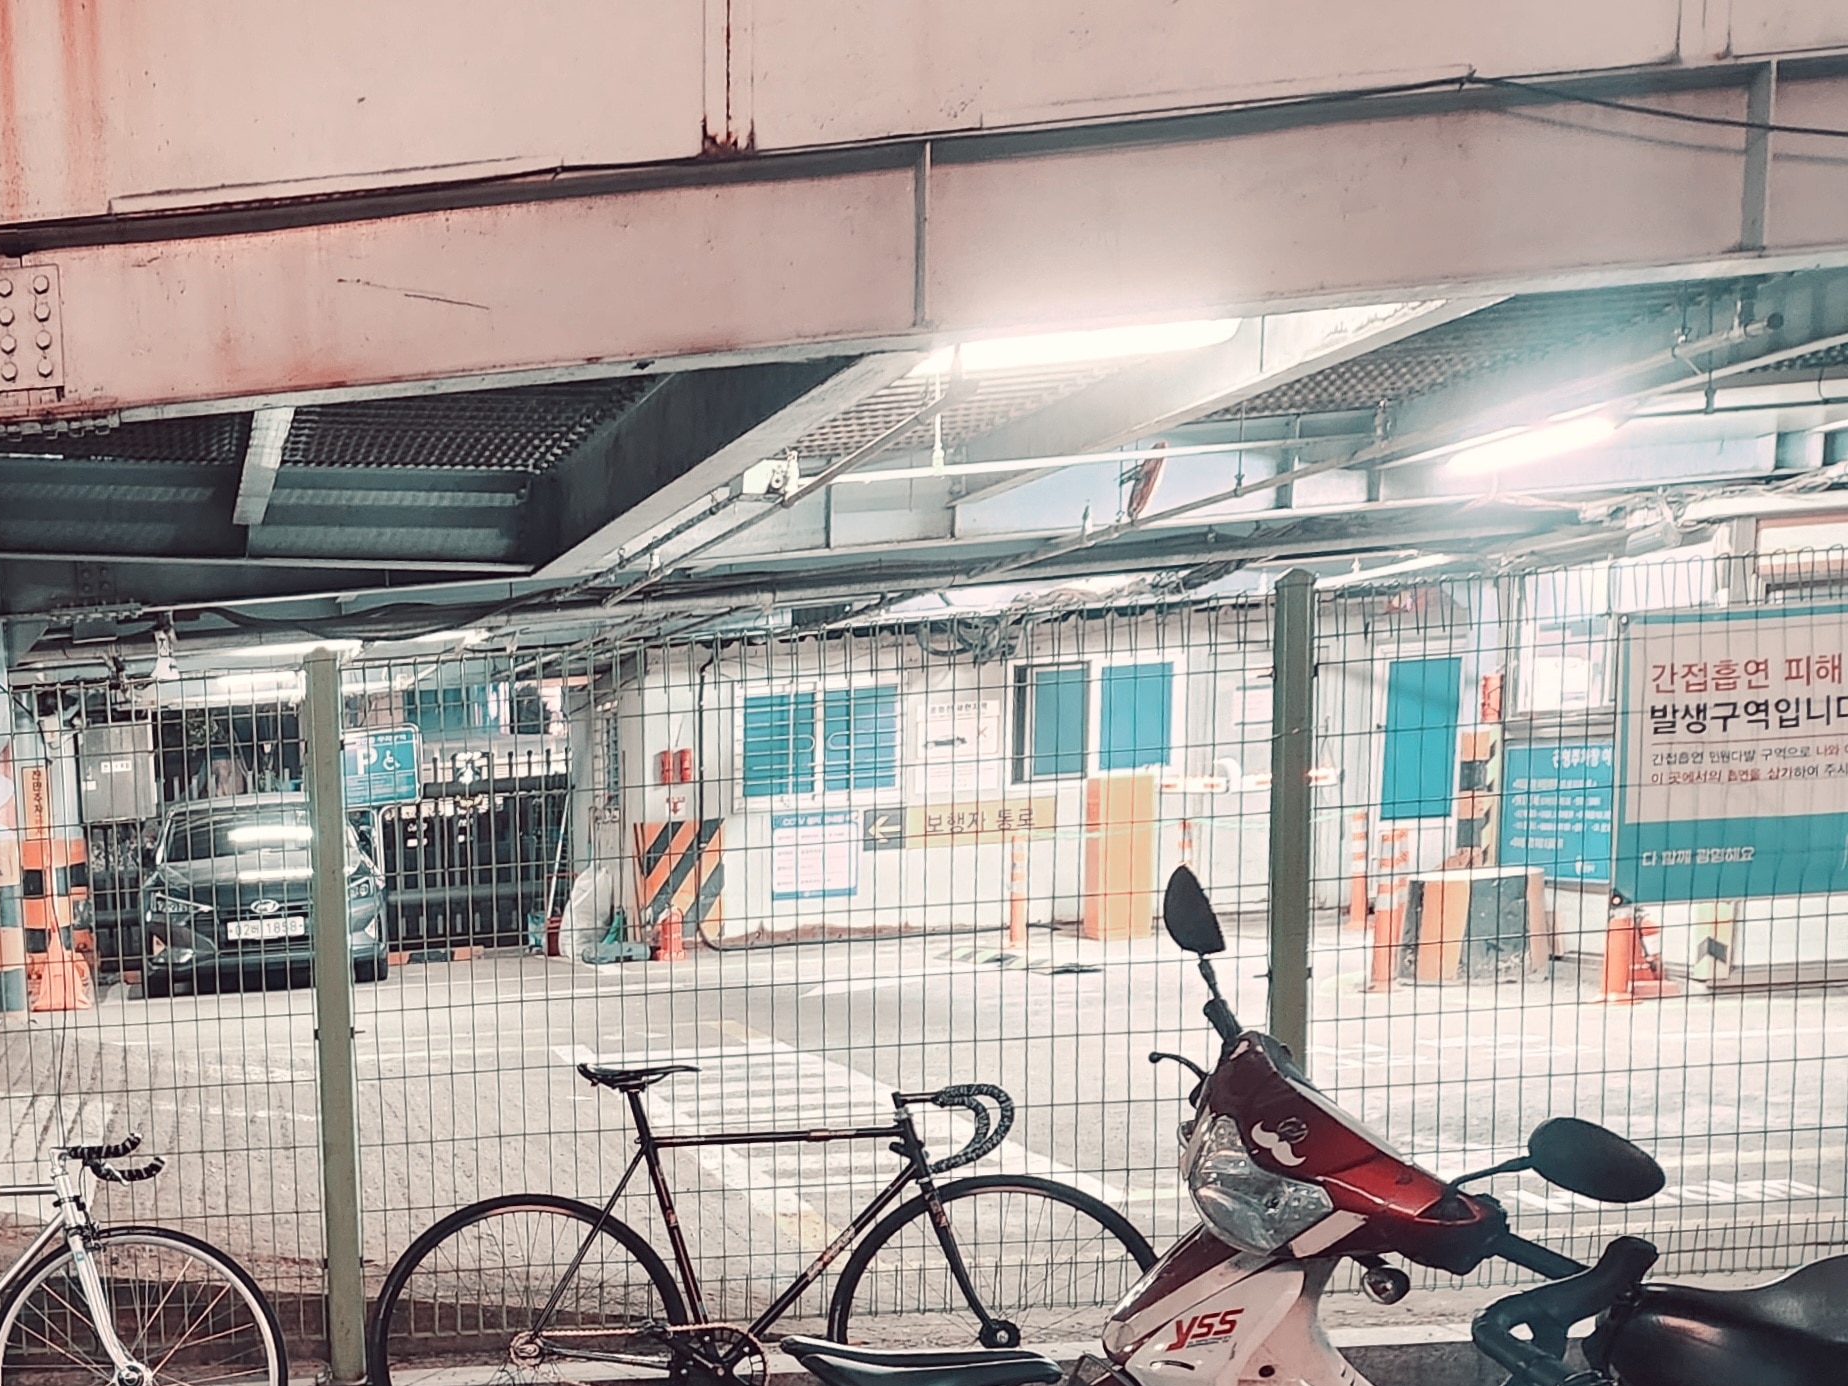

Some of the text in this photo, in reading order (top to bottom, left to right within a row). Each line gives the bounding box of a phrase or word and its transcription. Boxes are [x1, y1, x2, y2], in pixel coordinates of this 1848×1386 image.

[1651, 652, 1843, 694] 간접흡연 피해
[782, 816, 805, 826] CCV
[927, 807, 1036, 834] 보행자 통로
